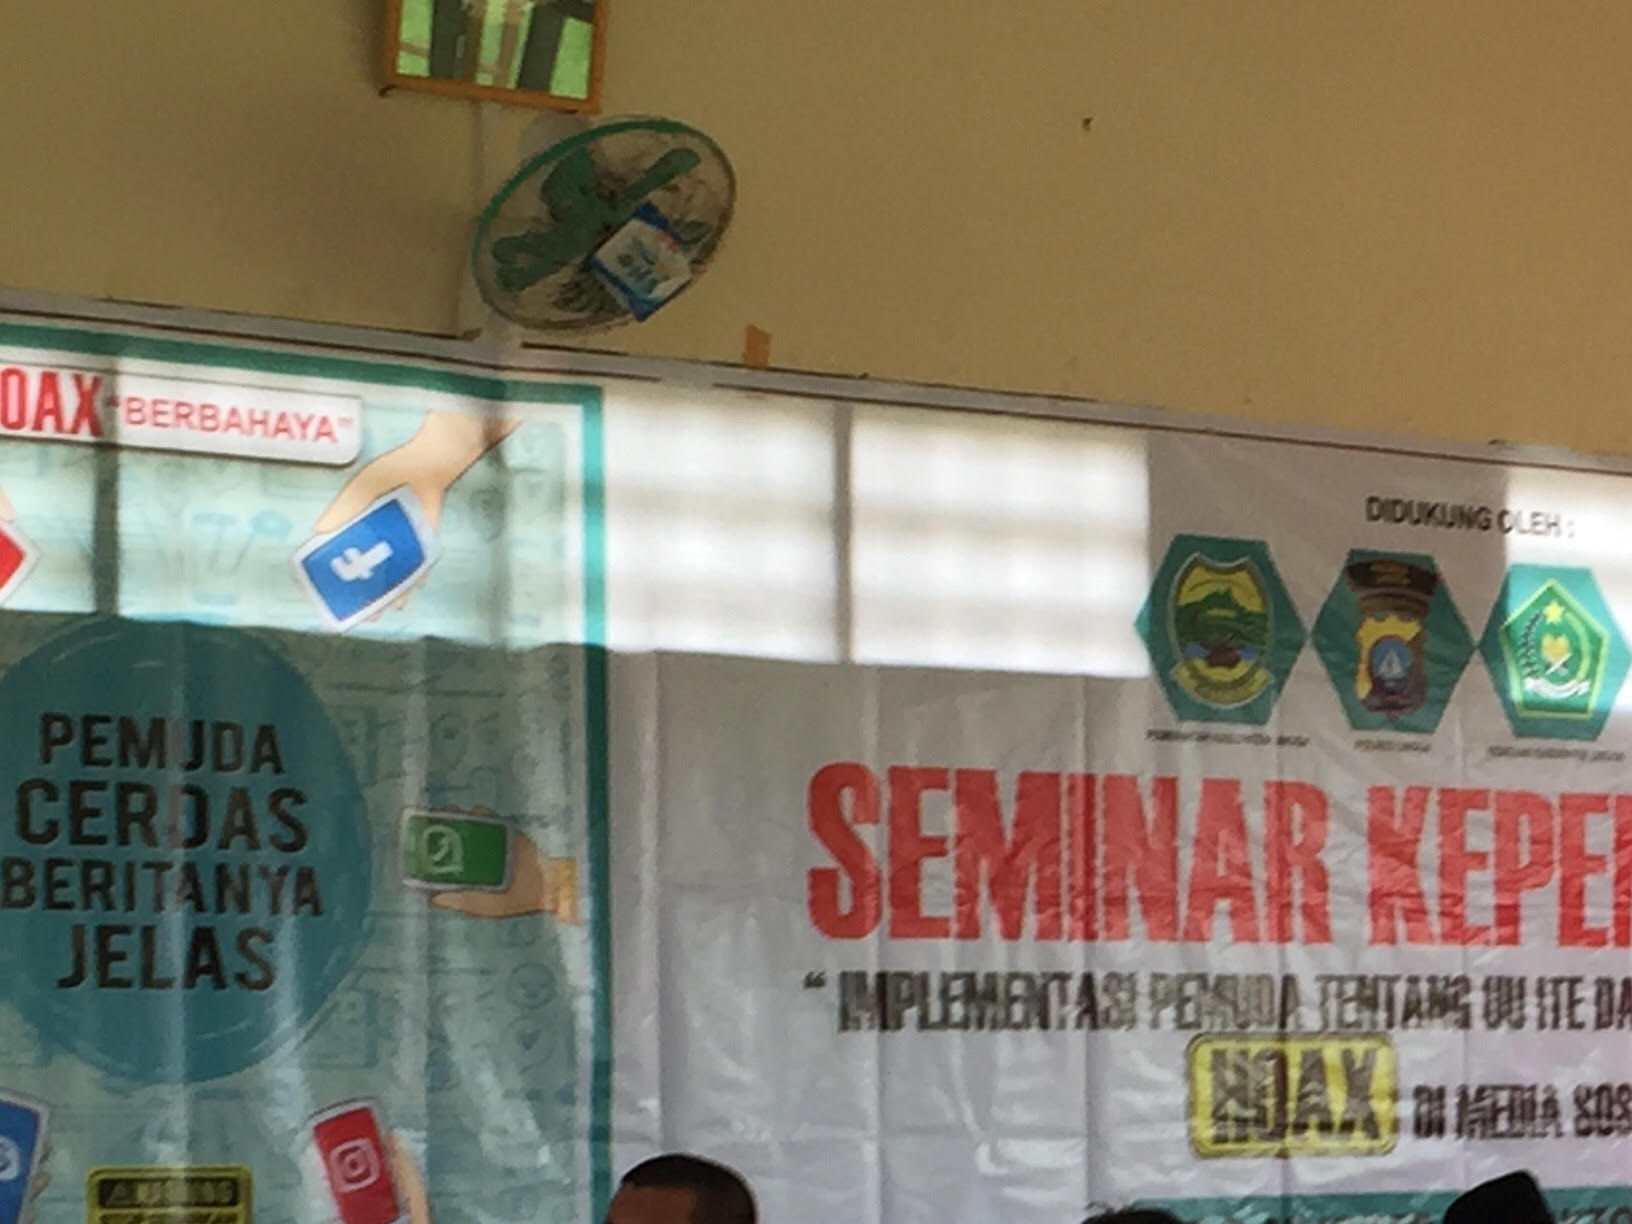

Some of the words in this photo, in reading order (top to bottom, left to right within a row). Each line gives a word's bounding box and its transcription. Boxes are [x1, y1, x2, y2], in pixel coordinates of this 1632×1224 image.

[0, 367, 103, 437] OAX
[1365, 496, 1492, 532] DIDUKUNG
[1497, 509, 1562, 538] OLEH
[40, 712, 285, 775] PEMUDA
[15, 777, 310, 853] CERDAS
[0, 856, 323, 917] BERITANYA
[807, 762, 1332, 945] SEMINAR
[57, 922, 277, 992] JELAS
[838, 970, 1137, 1033] IMPLEMENTASI
[1315, 973, 1472, 1032] TENTANG
[1535, 975, 1586, 1031] ITE
[1211, 1048, 1381, 1145] HOAX
[1413, 1084, 1447, 1139] DI
[1455, 1083, 1566, 1139] MEDIA
